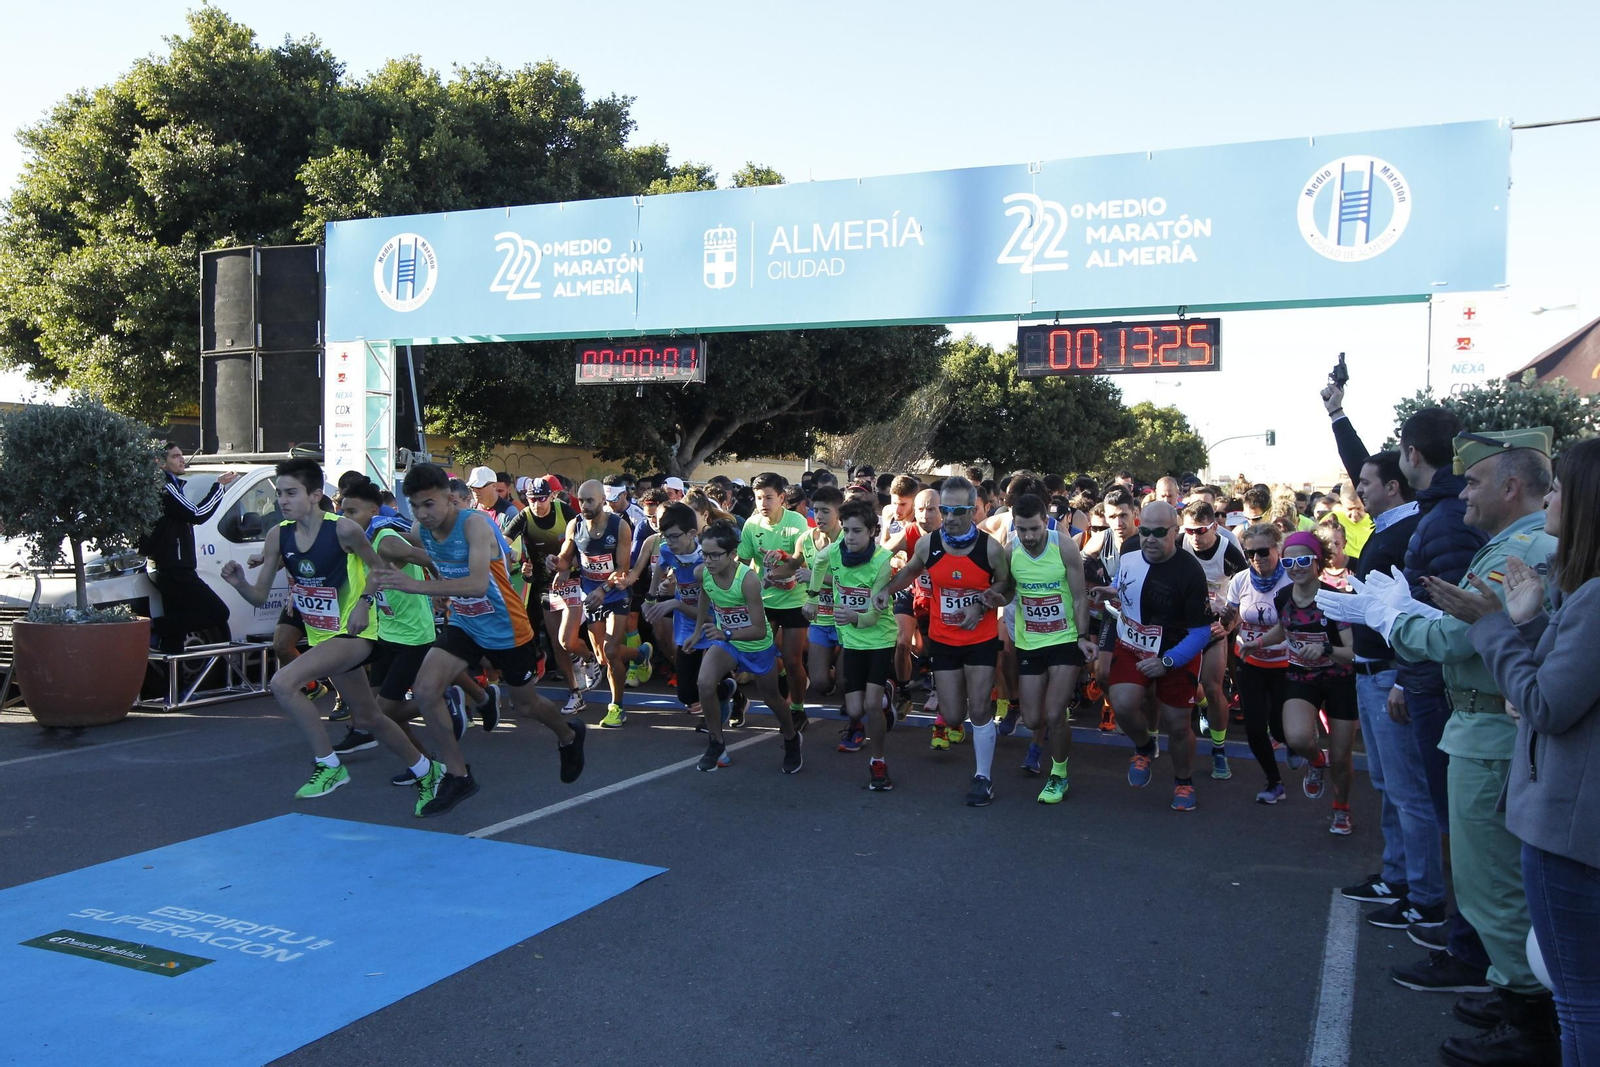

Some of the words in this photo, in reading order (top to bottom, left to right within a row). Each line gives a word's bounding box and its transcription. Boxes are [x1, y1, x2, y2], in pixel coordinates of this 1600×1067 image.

[1305, 170, 1331, 198] Medio
[1086, 196, 1167, 221] MEDIO
[767, 210, 925, 255] ALMERÍA
[1086, 213, 1212, 245] MARATÓN
[378, 243, 394, 264] Medio
[553, 238, 612, 258] MEDIO
[1085, 239, 1198, 269] ALMERÍA
[553, 253, 644, 278] MARATÓN
[767, 257, 845, 280] CIUDAD
[553, 273, 634, 298] ALMERÍA
[1049, 323, 1210, 370] 00:13:25
[1450, 363, 1485, 374] NEXA
[334, 405, 351, 415] CDX
[1020, 580, 1060, 590] DECATHLON
[297, 595, 333, 611] 5027
[1026, 605, 1060, 618] 5499
[1127, 627, 1158, 648] 6117
[68, 908, 305, 962] SUPERACIÓN
